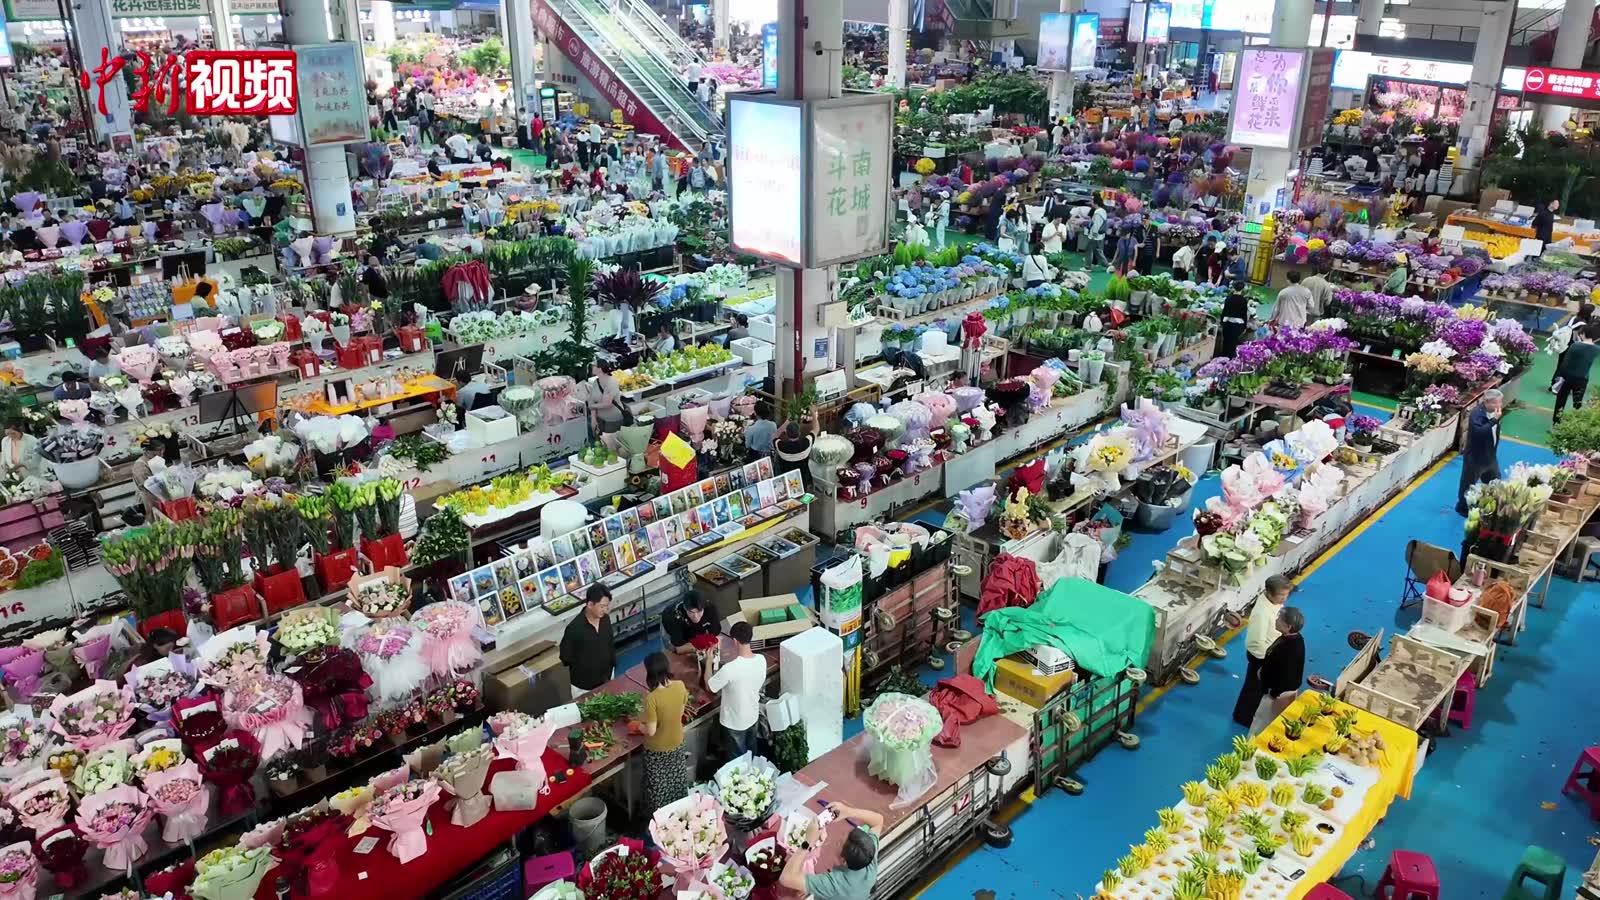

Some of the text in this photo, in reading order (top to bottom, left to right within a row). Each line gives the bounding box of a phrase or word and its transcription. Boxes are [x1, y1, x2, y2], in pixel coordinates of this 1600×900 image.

[112, 0, 201, 12] 花卉远程拍卖
[1376, 59, 1439, 80] 花之恋
[828, 149, 872, 181] 斗南
[827, 184, 871, 216] 花城
[541, 335, 548, 344] 8
[488, 346, 496, 356] 9
[182, 415, 199, 428] 13
[547, 432, 561, 446] 10
[403, 477, 420, 490] 12
[914, 475, 921, 486] 8
[860, 497, 868, 509] 9
[952, 793, 971, 817] 12
